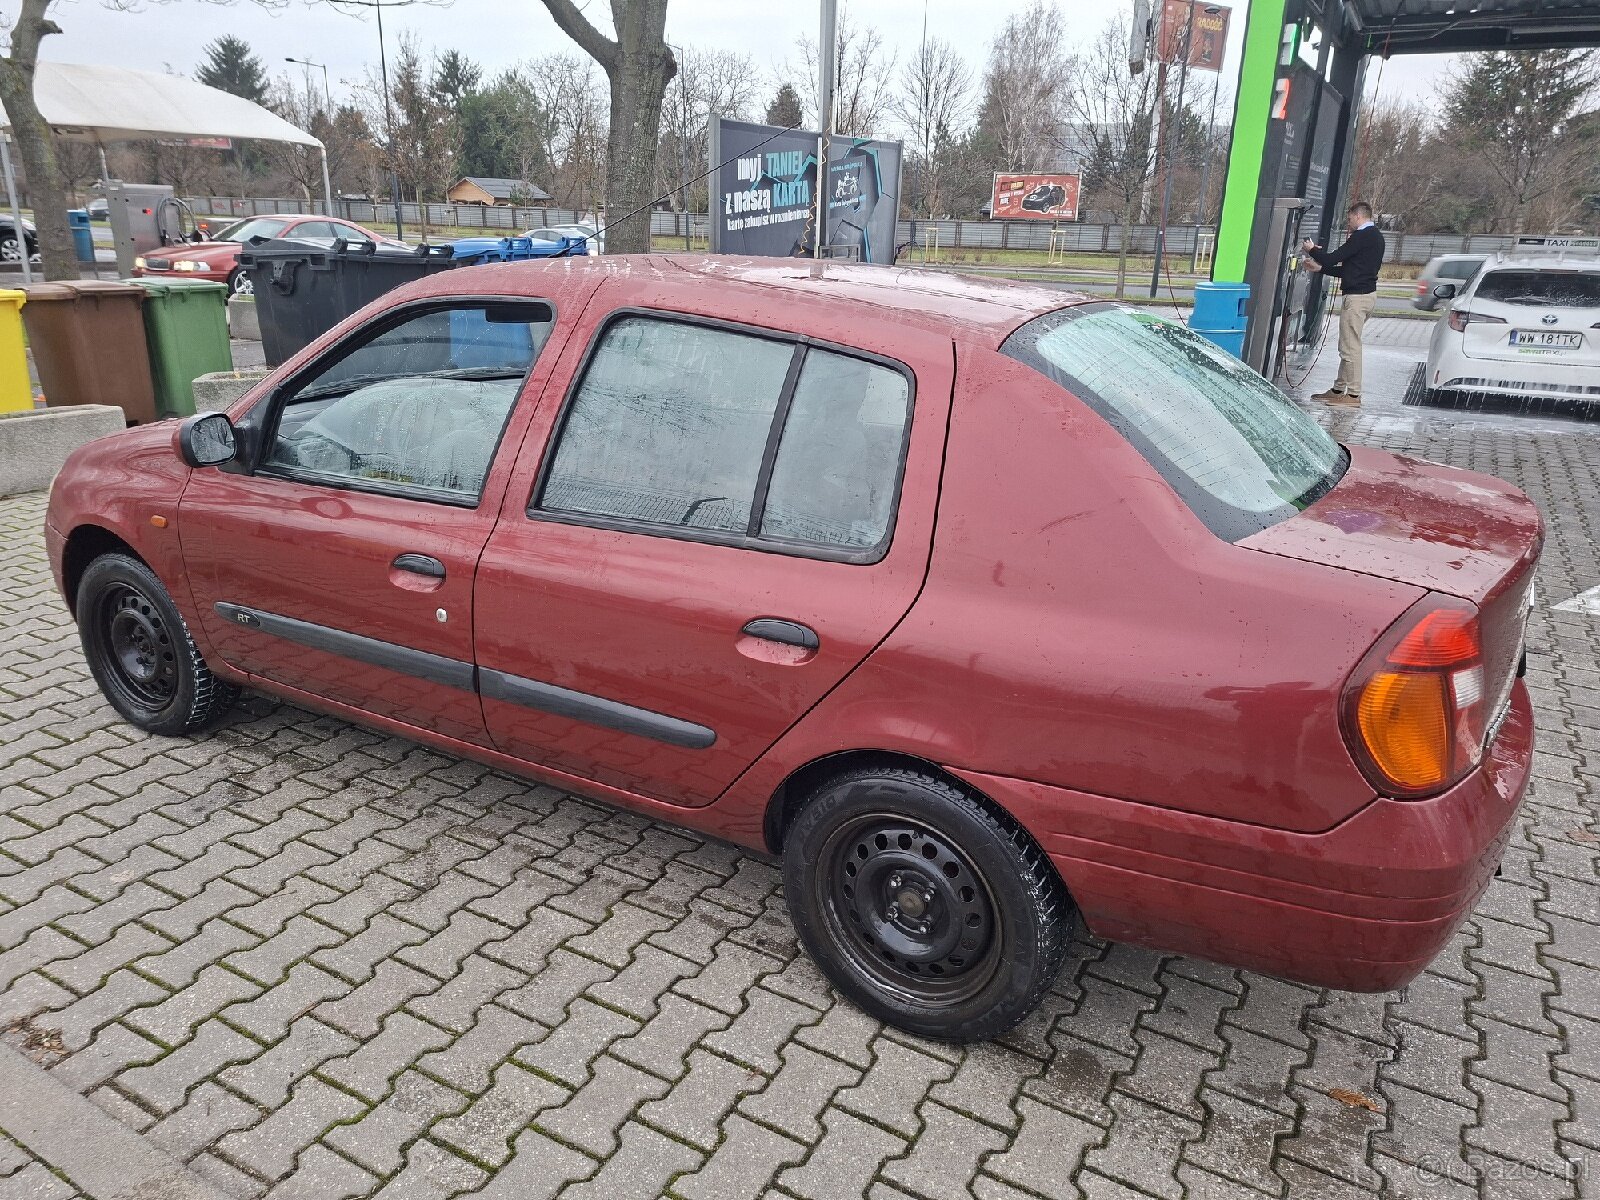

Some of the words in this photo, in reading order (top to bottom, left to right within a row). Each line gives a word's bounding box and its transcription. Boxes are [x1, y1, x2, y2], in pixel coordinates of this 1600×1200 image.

[737, 153, 762, 182] myj
[725, 192, 733, 214] z
[733, 189, 771, 213] naszą
[773, 180, 810, 207] KARTĄ
[1546, 239, 1569, 247] TAXI
[1519, 333, 1535, 344] WW
[1540, 333, 1578, 346] 181TK
[237, 613, 251, 623] RT
